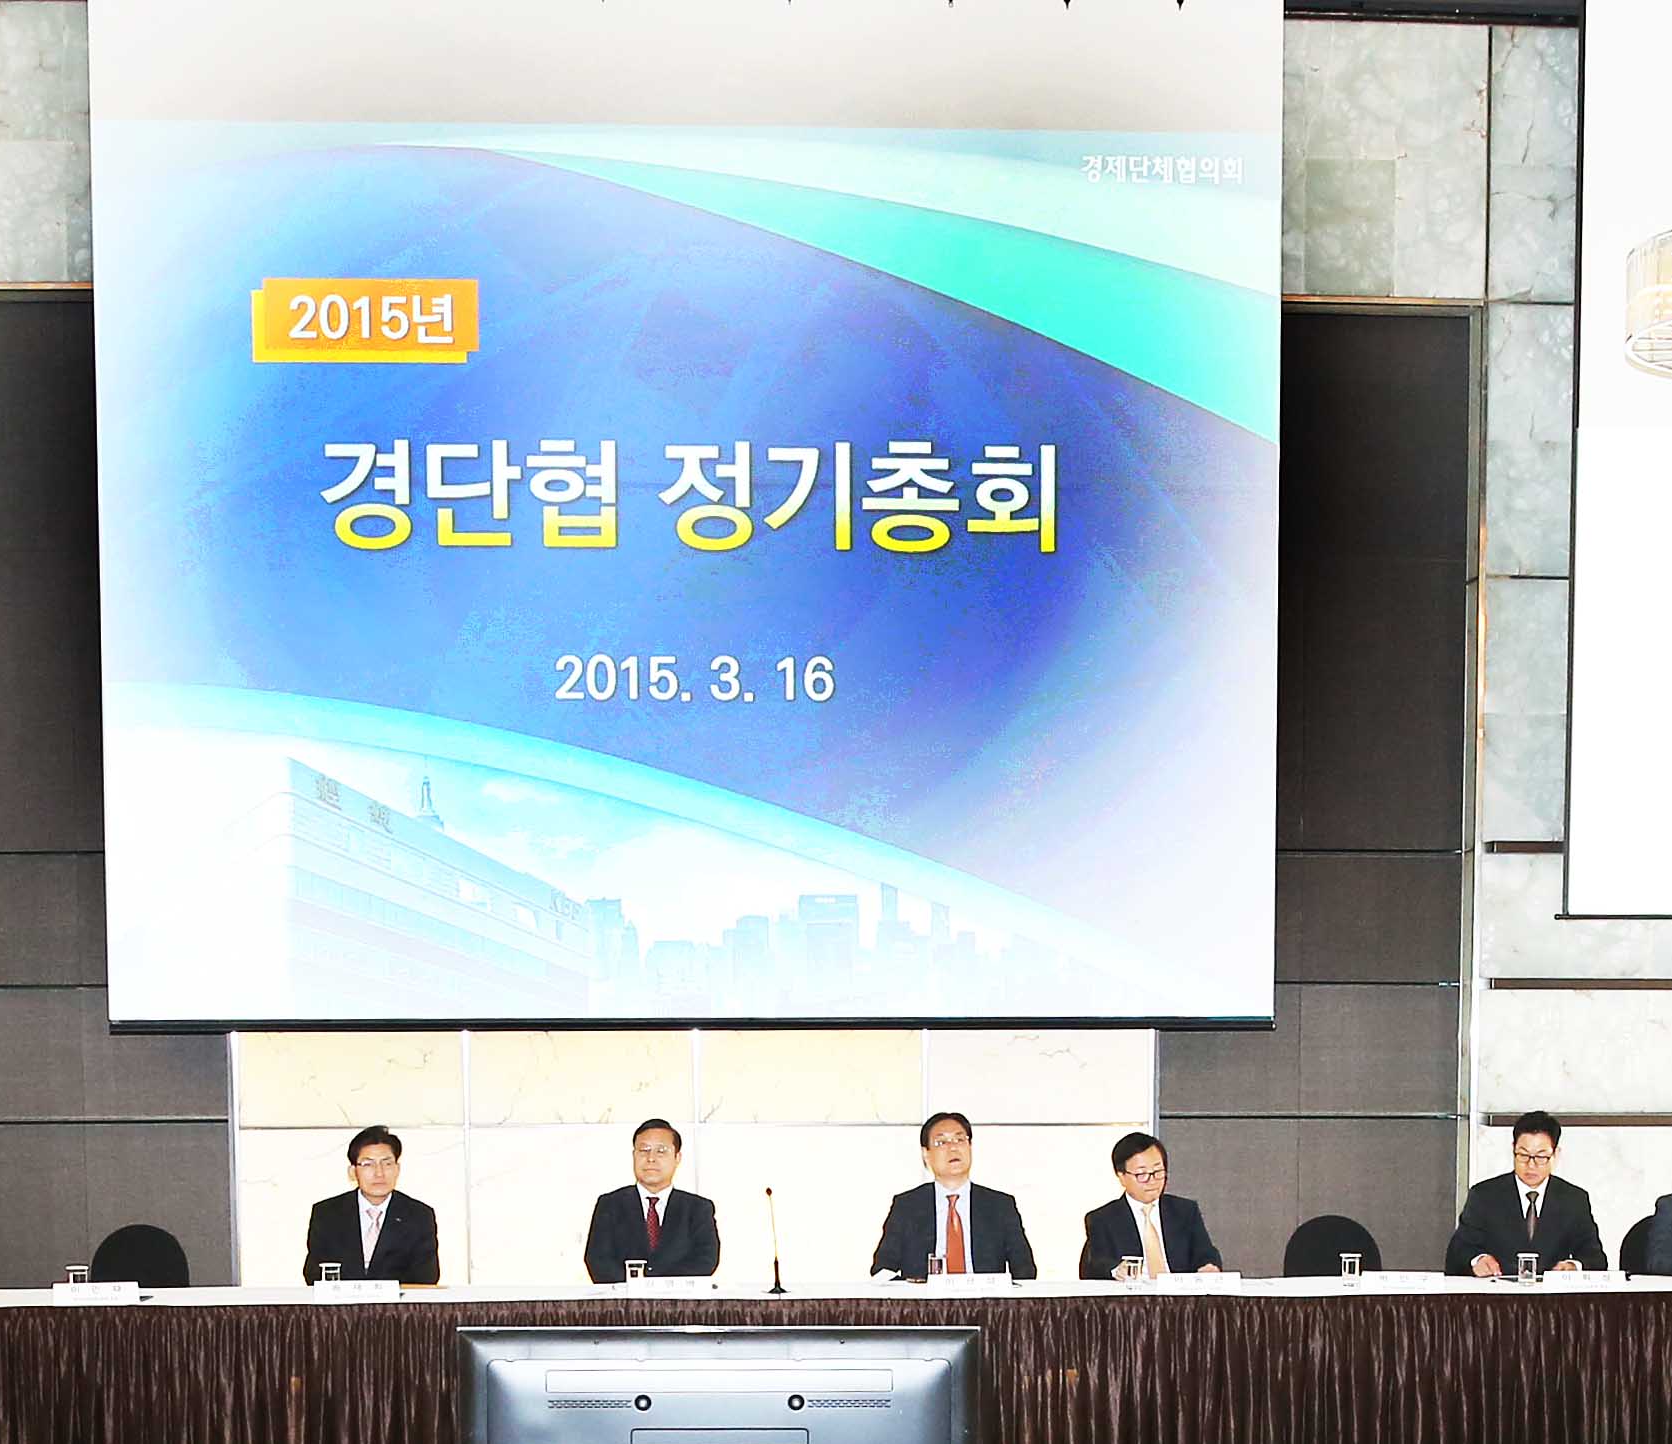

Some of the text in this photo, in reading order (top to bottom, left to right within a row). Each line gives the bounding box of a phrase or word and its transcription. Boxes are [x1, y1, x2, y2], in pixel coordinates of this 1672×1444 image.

[1081, 155, 1244, 185] 경제단체협의회
[288, 294, 454, 345] 2015년
[320, 439, 1057, 553] 경단협 정기총회
[555, 653, 835, 703] 2015. 3. 16
